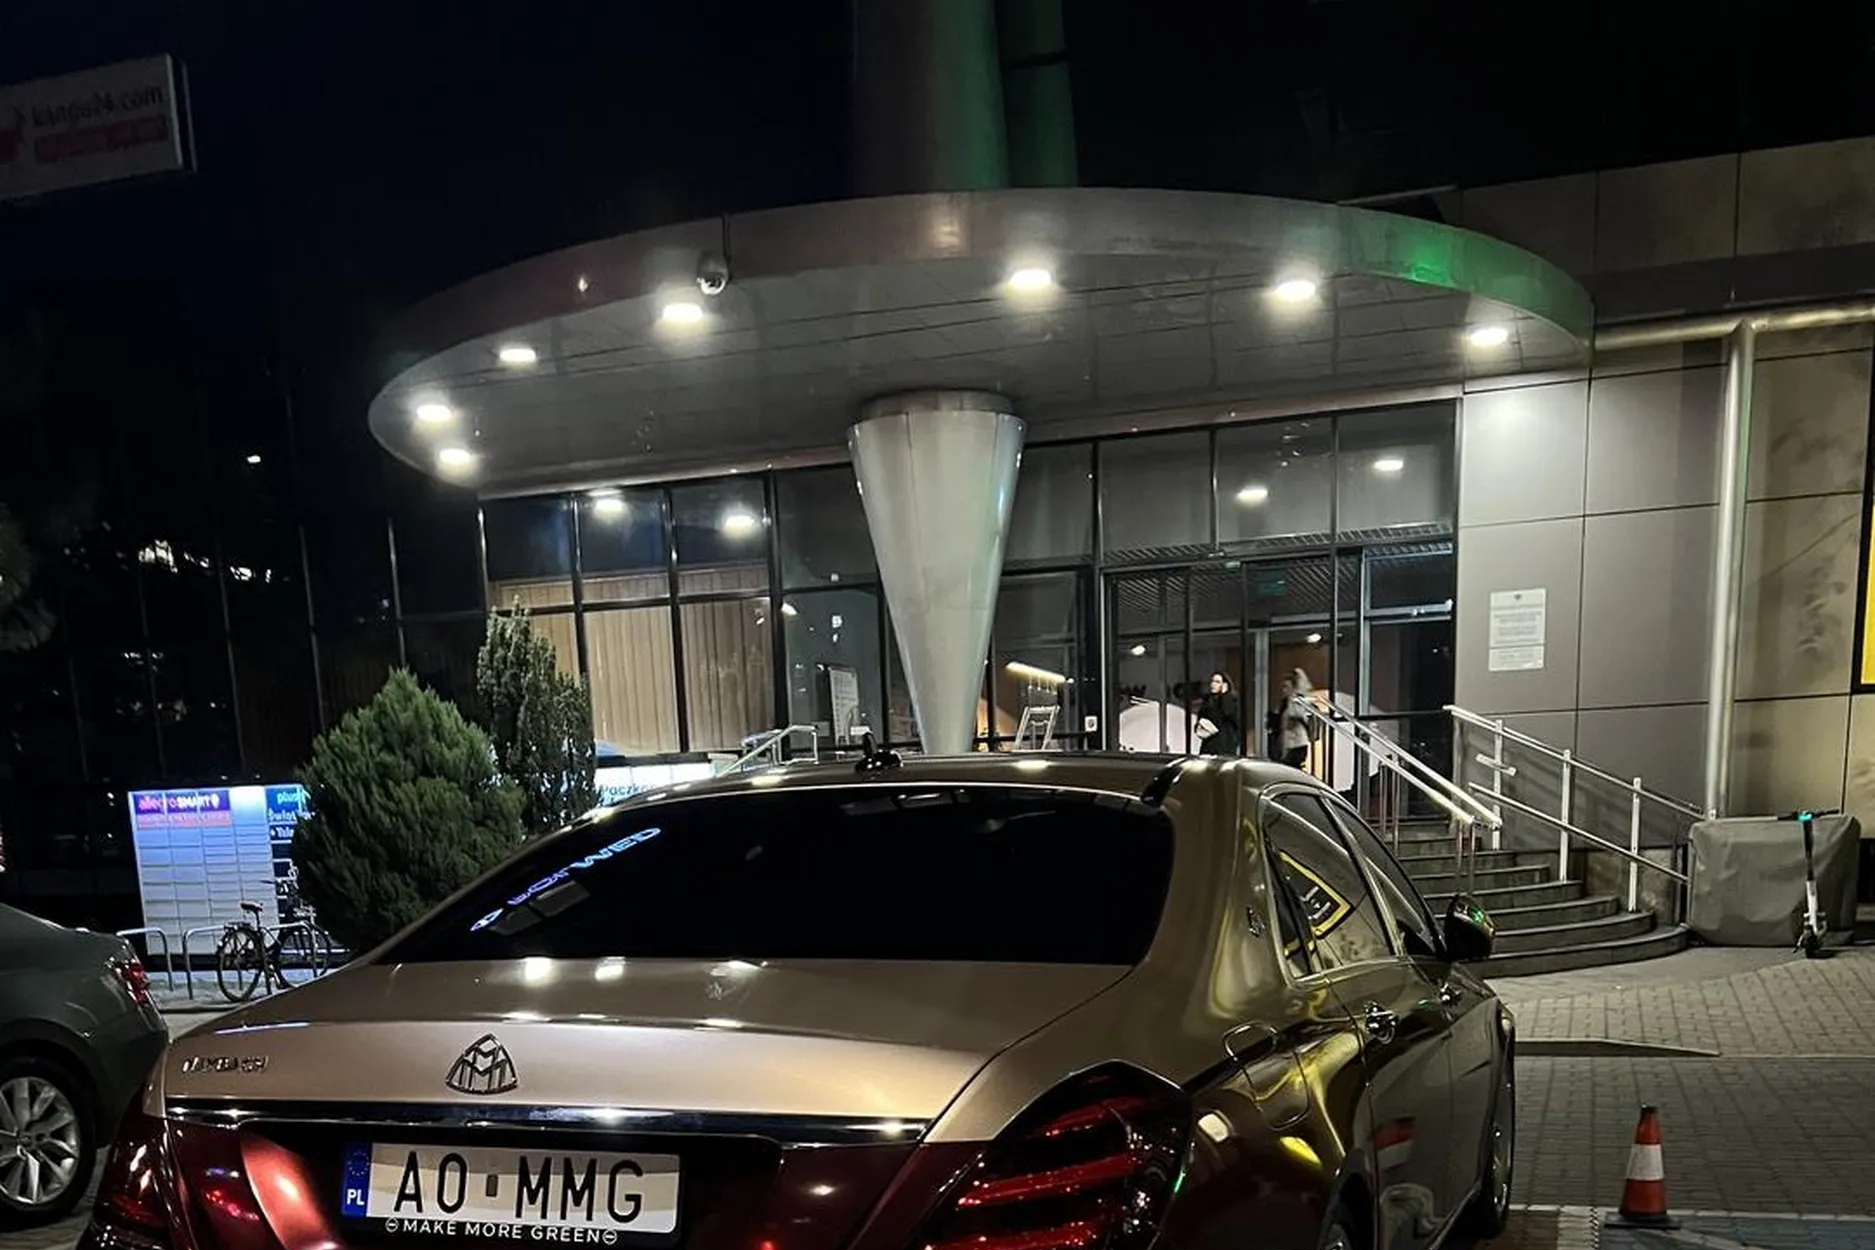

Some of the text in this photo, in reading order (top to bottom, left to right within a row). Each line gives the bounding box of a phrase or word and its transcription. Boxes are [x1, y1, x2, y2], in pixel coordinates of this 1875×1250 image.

[346, 1188, 365, 1206] PL
[515, 1155, 643, 1223] MMG
[402, 1219, 599, 1243] MAKE MORE GREEN
